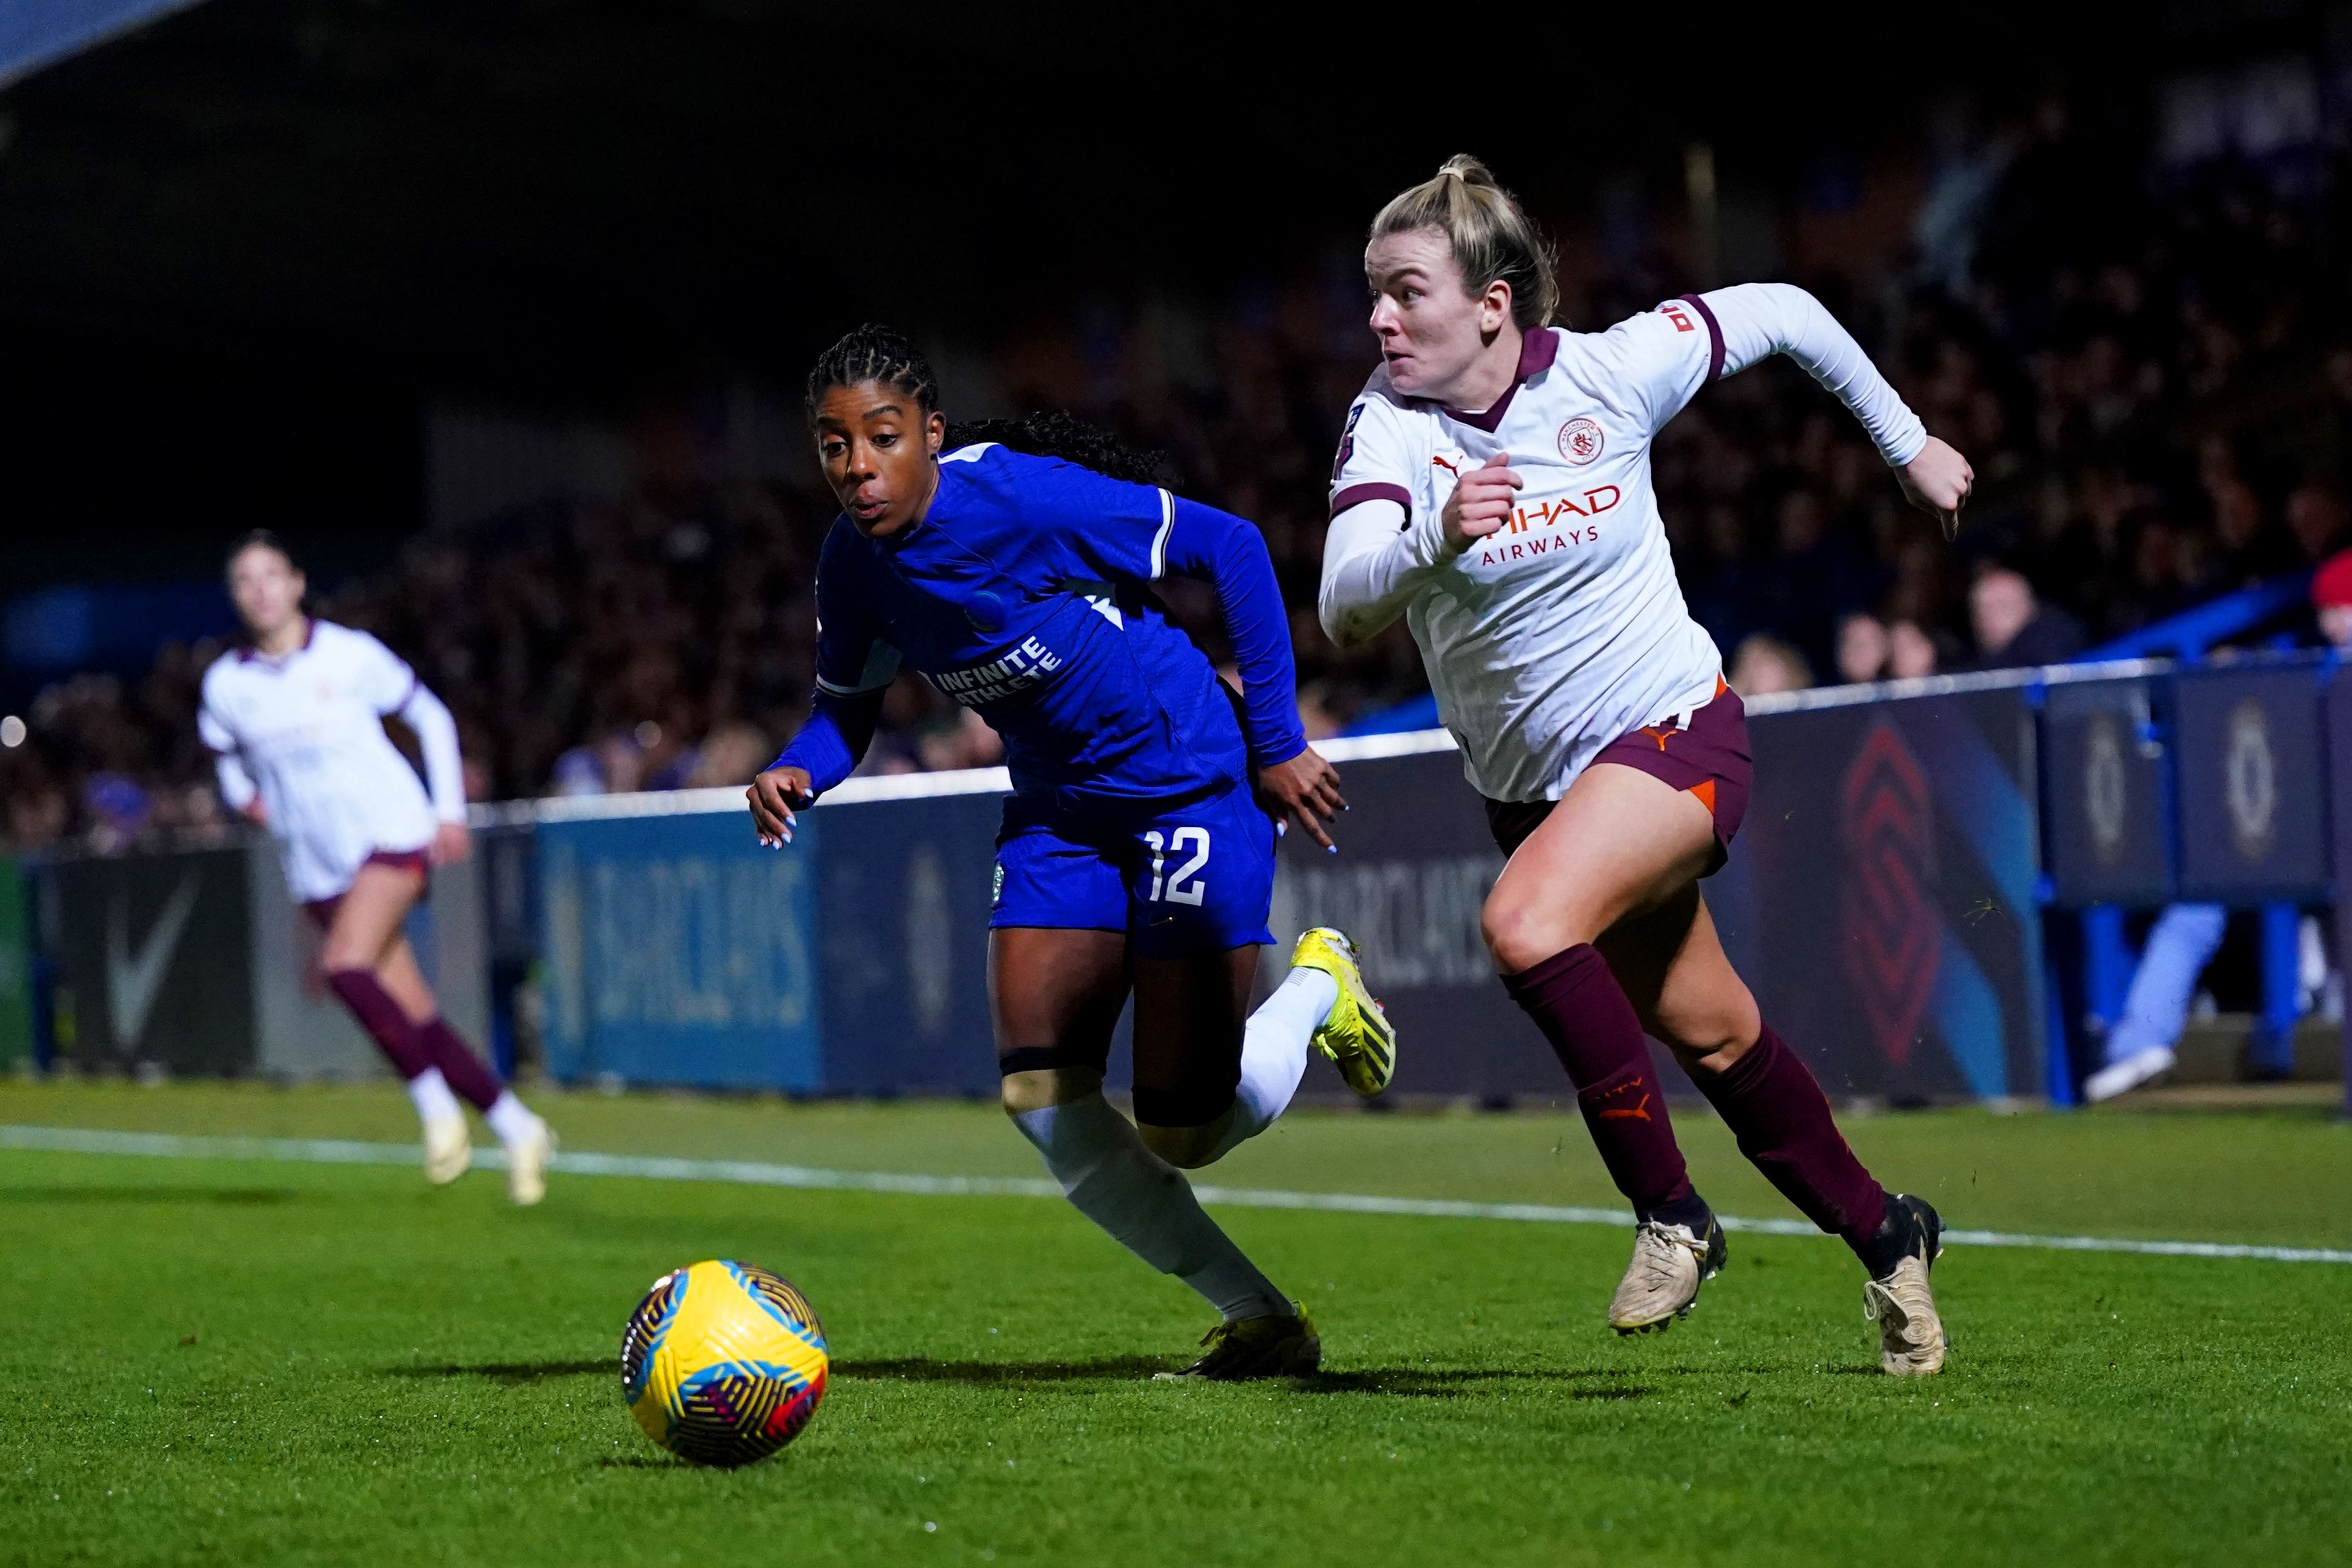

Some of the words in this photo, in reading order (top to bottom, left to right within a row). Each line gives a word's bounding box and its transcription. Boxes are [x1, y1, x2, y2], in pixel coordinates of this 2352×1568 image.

[1562, 421, 1595, 442] MANCHESTER
[1486, 485, 1621, 540] IHAD
[1482, 526, 1598, 566] AIRWAYS
[937, 636, 1046, 691] INFINITE
[955, 651, 1062, 705] ATHLETE
[1144, 826, 1211, 907] 12
